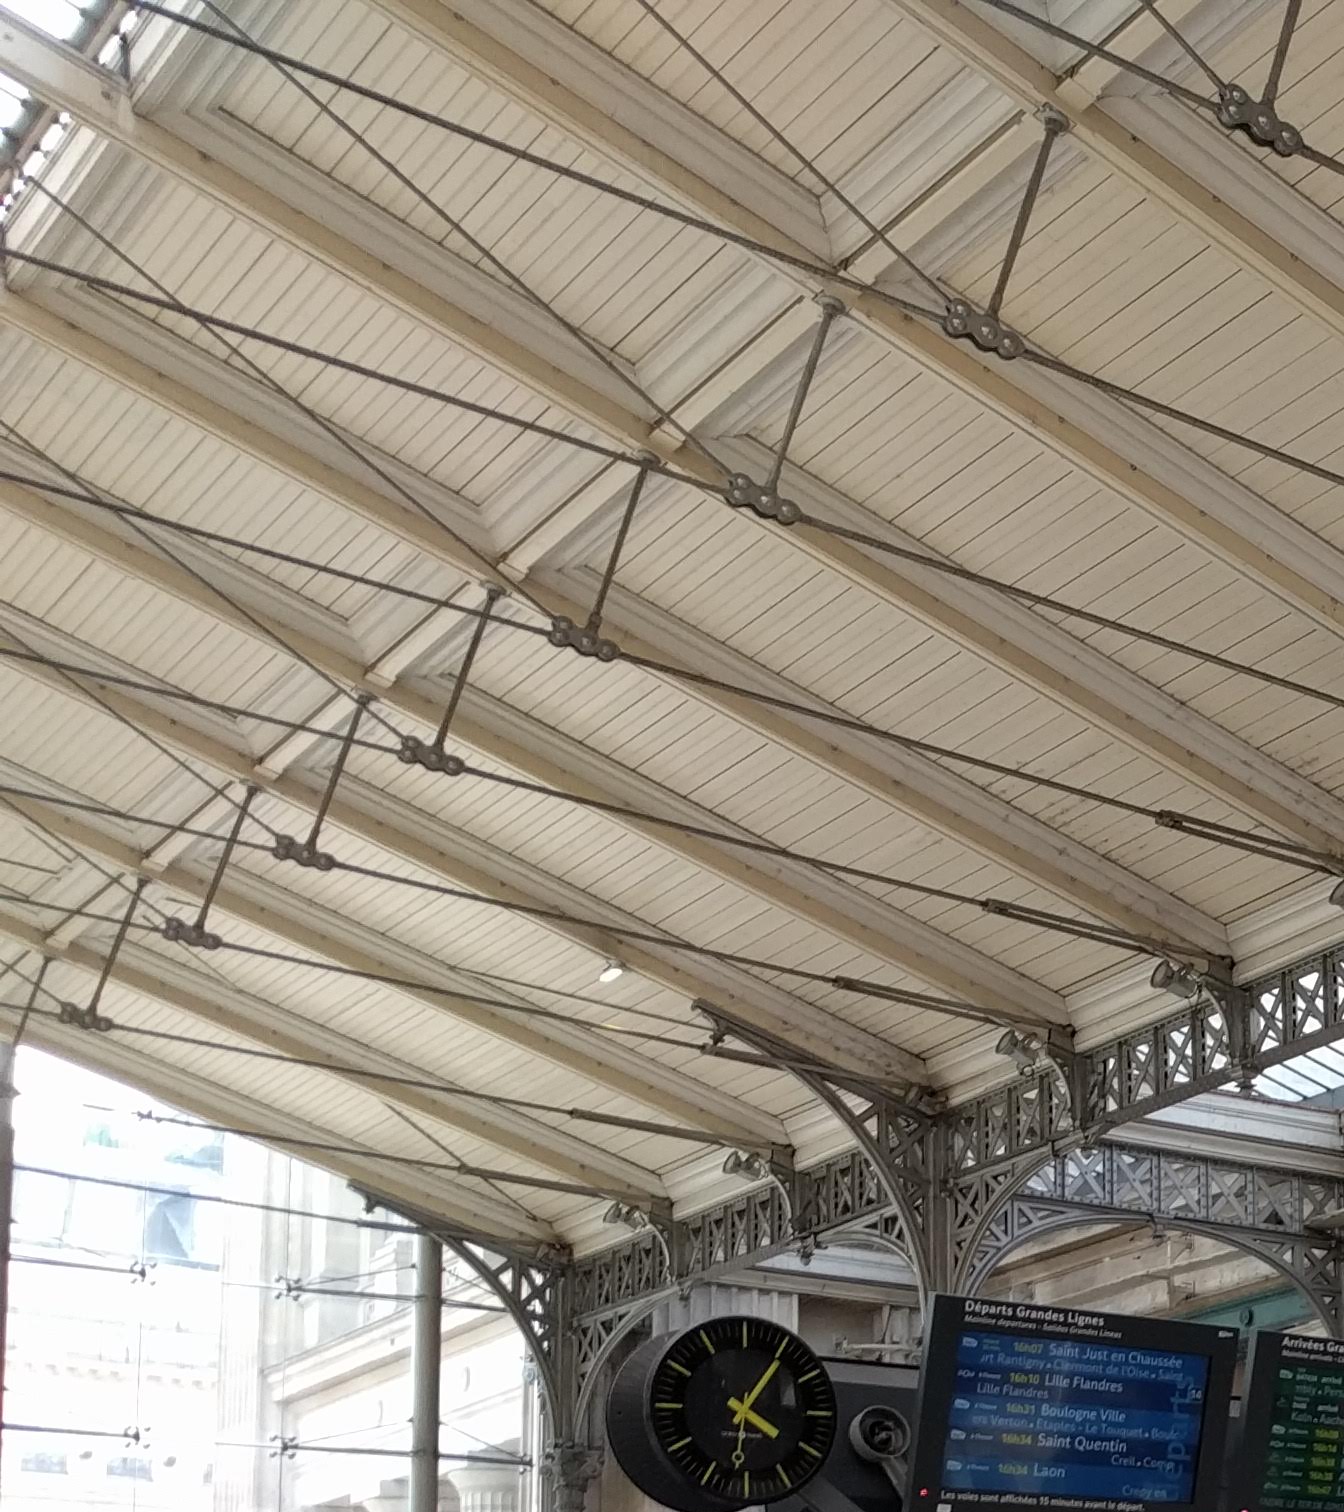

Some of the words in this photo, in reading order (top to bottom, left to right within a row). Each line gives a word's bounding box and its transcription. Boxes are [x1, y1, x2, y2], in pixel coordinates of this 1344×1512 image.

[964, 1300, 1013, 1317] Départs
[1016, 1306, 1065, 1323] Grandes
[1068, 1312, 1105, 1327] Lignes
[1281, 1336, 1325, 1351] Arrivées
[997, 1355, 1046, 1370] Rantigny
[1053, 1358, 1103, 1374] Clermont
[1106, 1365, 1120, 1375] de
[1048, 1343, 1079, 1360] Saint
[1082, 1348, 1108, 1362] Just
[1112, 1352, 1126, 1362] en
[1128, 1352, 1183, 1368] Chaussée
[977, 1383, 1000, 1394] Lille
[1002, 1384, 1048, 1398] Flandres
[1045, 1374, 1070, 1388] Lille
[1072, 1378, 1123, 1393] Flandres
[1041, 1403, 1097, 1421] Boulogne
[1100, 1408, 1126, 1423] Ville
[990, 1415, 1028, 1428] Verton
[1100, 1423, 1142, 1440] Touquet
[1037, 1433, 1071, 1448] Saint
[1075, 1436, 1127, 1453] Quentin
[1033, 1463, 1066, 1478] Laon
[1111, 1455, 1135, 1467] Creil
[940, 1489, 956, 1500] Les
